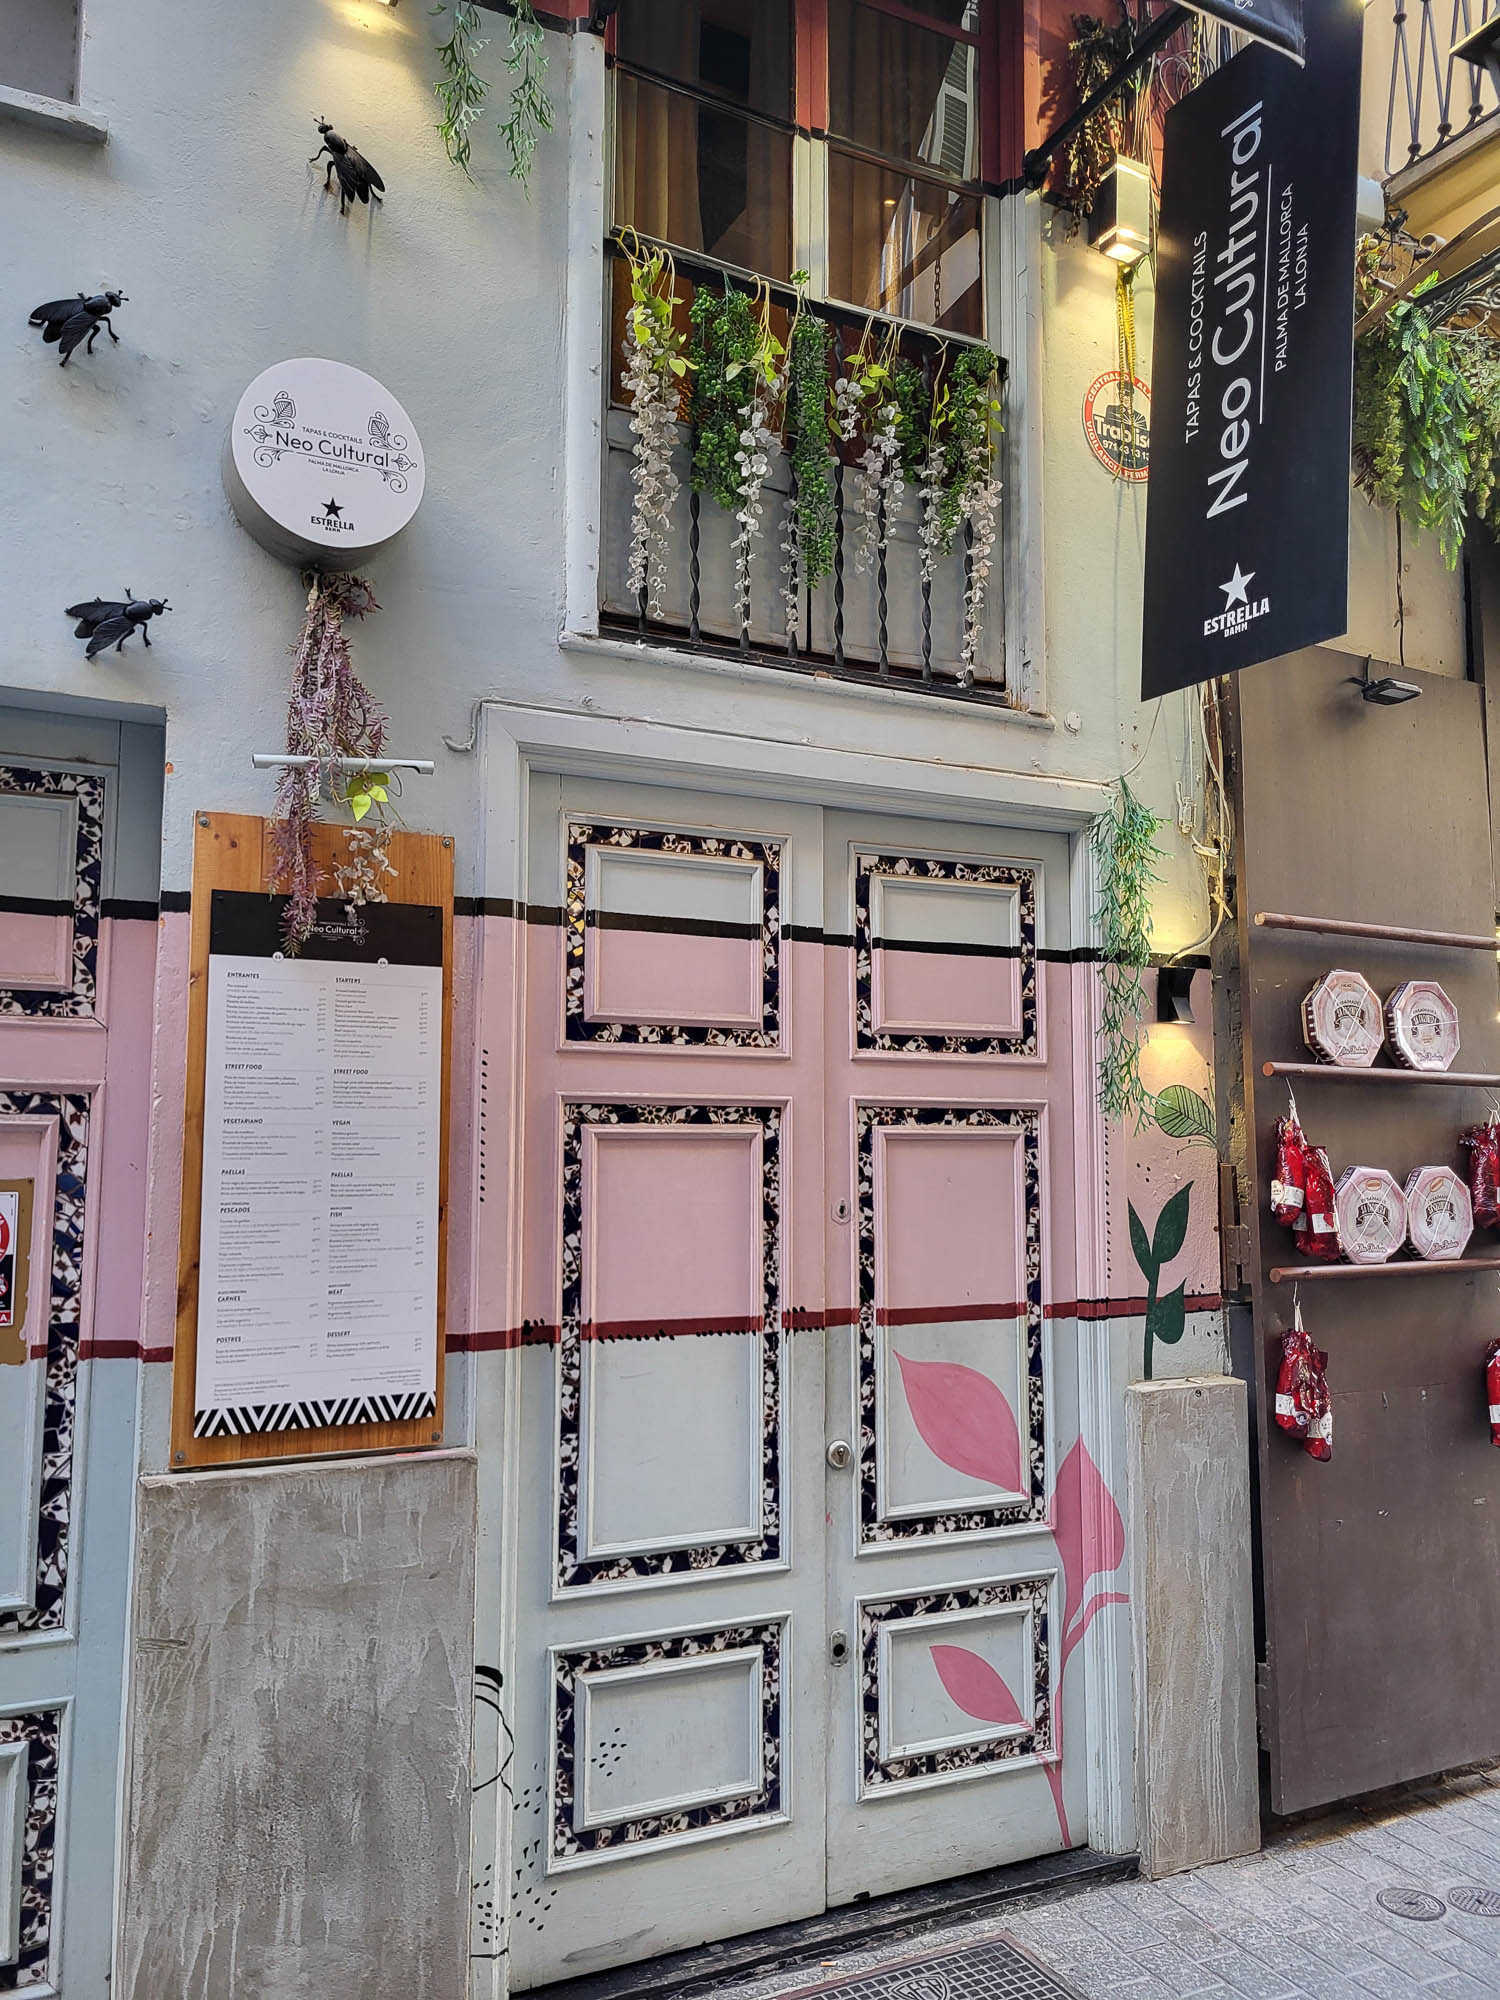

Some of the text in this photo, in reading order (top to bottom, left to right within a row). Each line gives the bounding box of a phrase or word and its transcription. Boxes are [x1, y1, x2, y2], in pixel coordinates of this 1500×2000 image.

[1294, 223, 1309, 310] LA LONJA
[1275, 183, 1293, 372] PALMA DE MALLORCA
[1206, 100, 1263, 519] Neo Cultural
[1185, 231, 1207, 444] TAPAS & COCKTAILS
[1088, 372, 1121, 402] CENTRAL
[302, 426, 322, 436] TAPAS
[328, 432, 363, 444] COCKTAILS
[1094, 416, 1150, 448] Trabis
[276, 430, 389, 467] Neo Cultural
[1086, 420, 1119, 472] VIGILANCI
[1103, 439, 1118, 452] 971
[310, 515, 355, 532] ESTRELLA
[1203, 596, 1271, 636] ESTRELLA
[1223, 621, 1248, 638] DAMM
[325, 925, 358, 935] Cultural
[227, 971, 260, 979] ENTRANTES
[221, 1168, 246, 1176] PAELLAS
[219, 1206, 251, 1214] PESCADOS
[217, 1295, 241, 1303] CARNES
[215, 1336, 242, 1344] POSTRES
